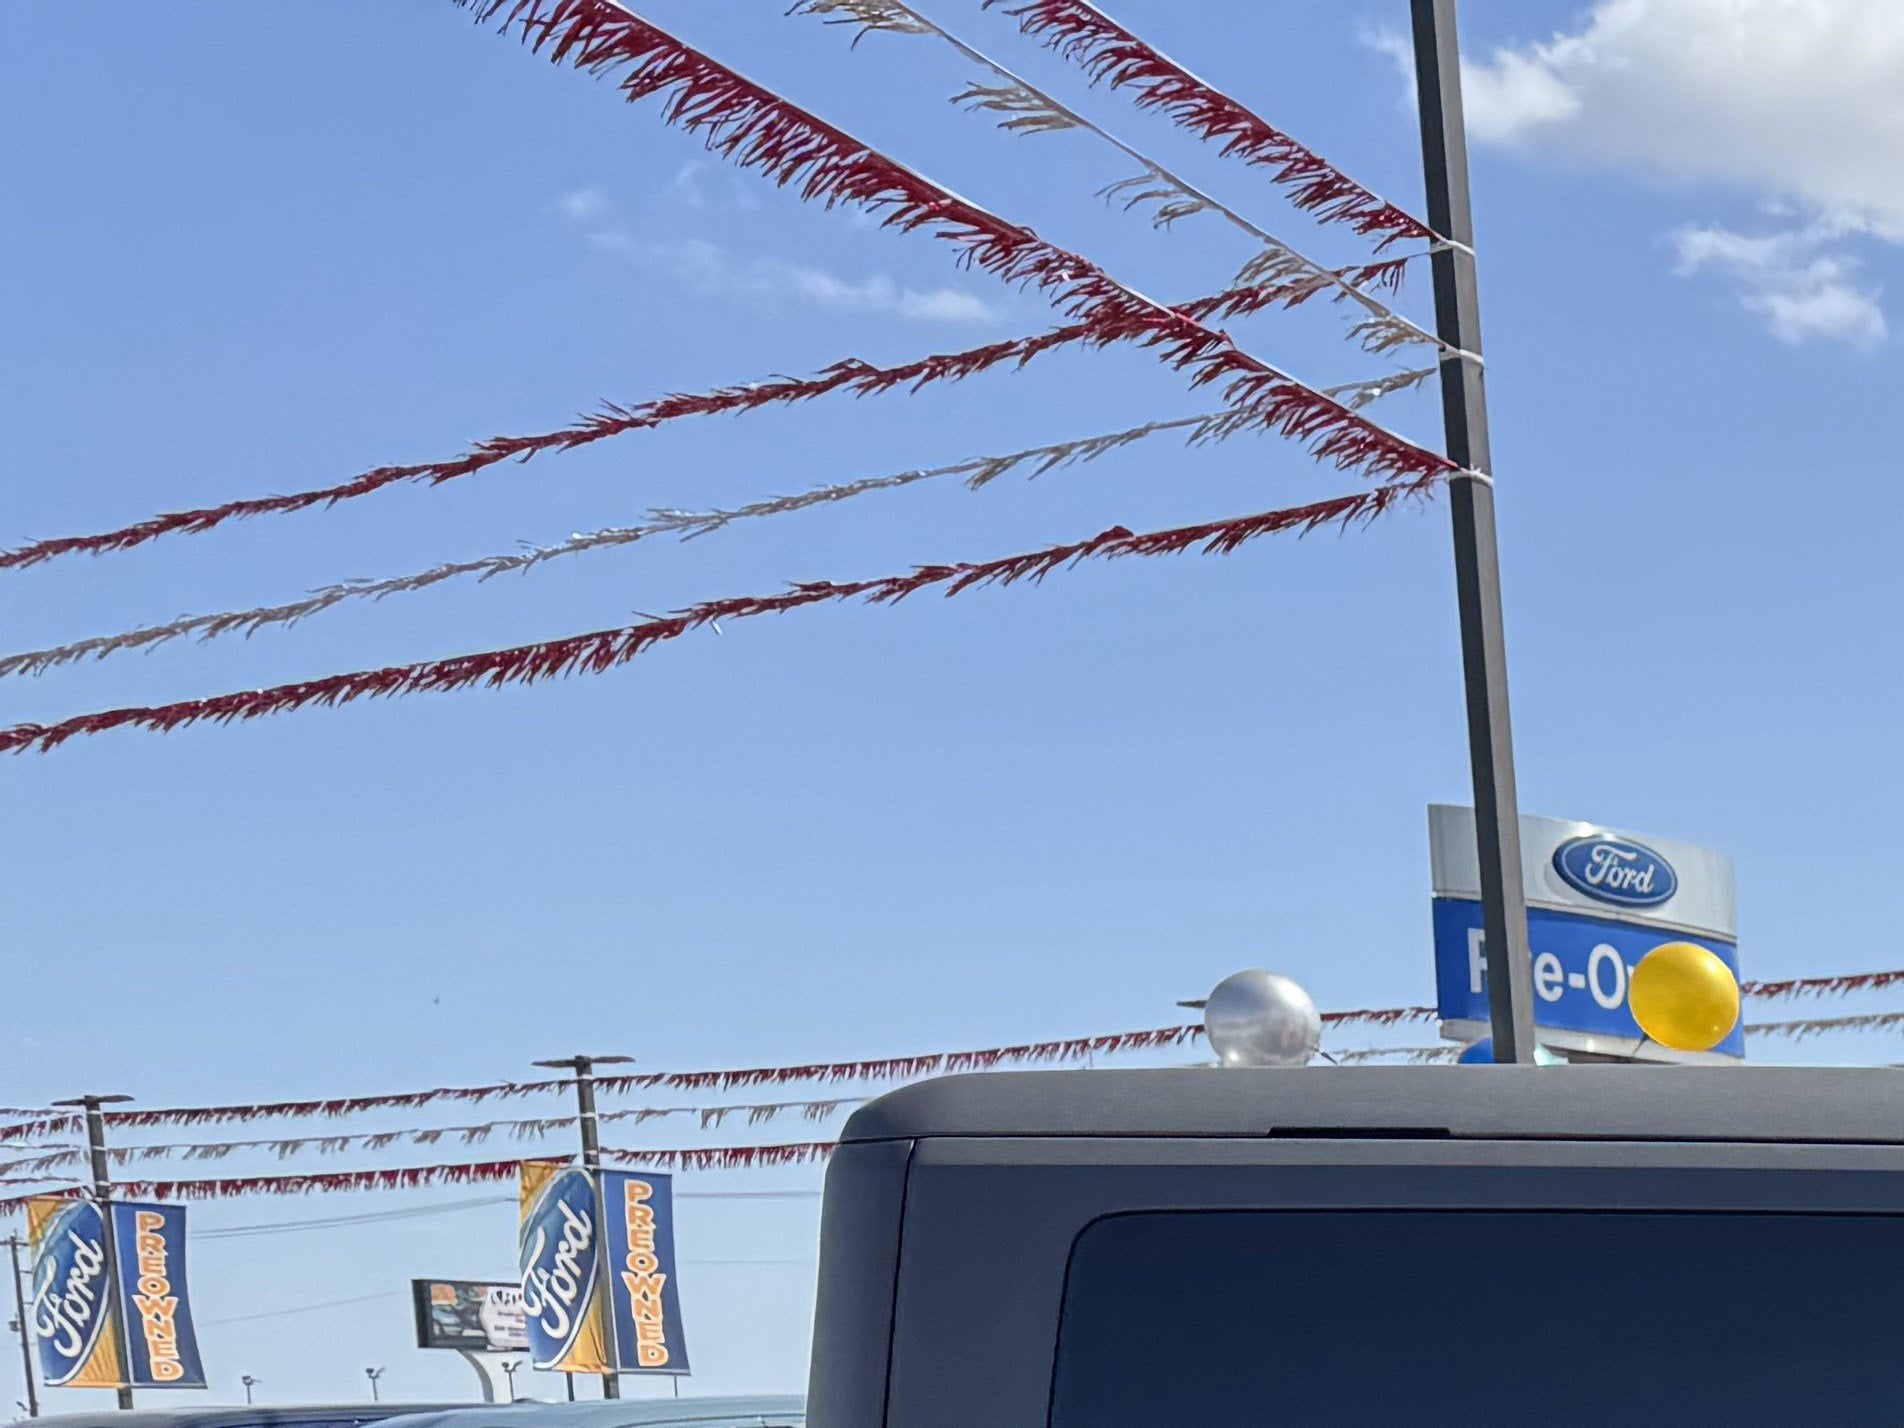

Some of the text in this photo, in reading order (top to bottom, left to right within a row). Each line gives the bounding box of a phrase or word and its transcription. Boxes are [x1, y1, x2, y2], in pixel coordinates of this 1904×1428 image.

[1584, 844, 1655, 894] Ford
[36, 1228, 104, 1357] Ford
[132, 1211, 184, 1381] PREOWNED
[522, 1199, 592, 1339] Ford
[621, 1179, 669, 1367] PREOWNED
